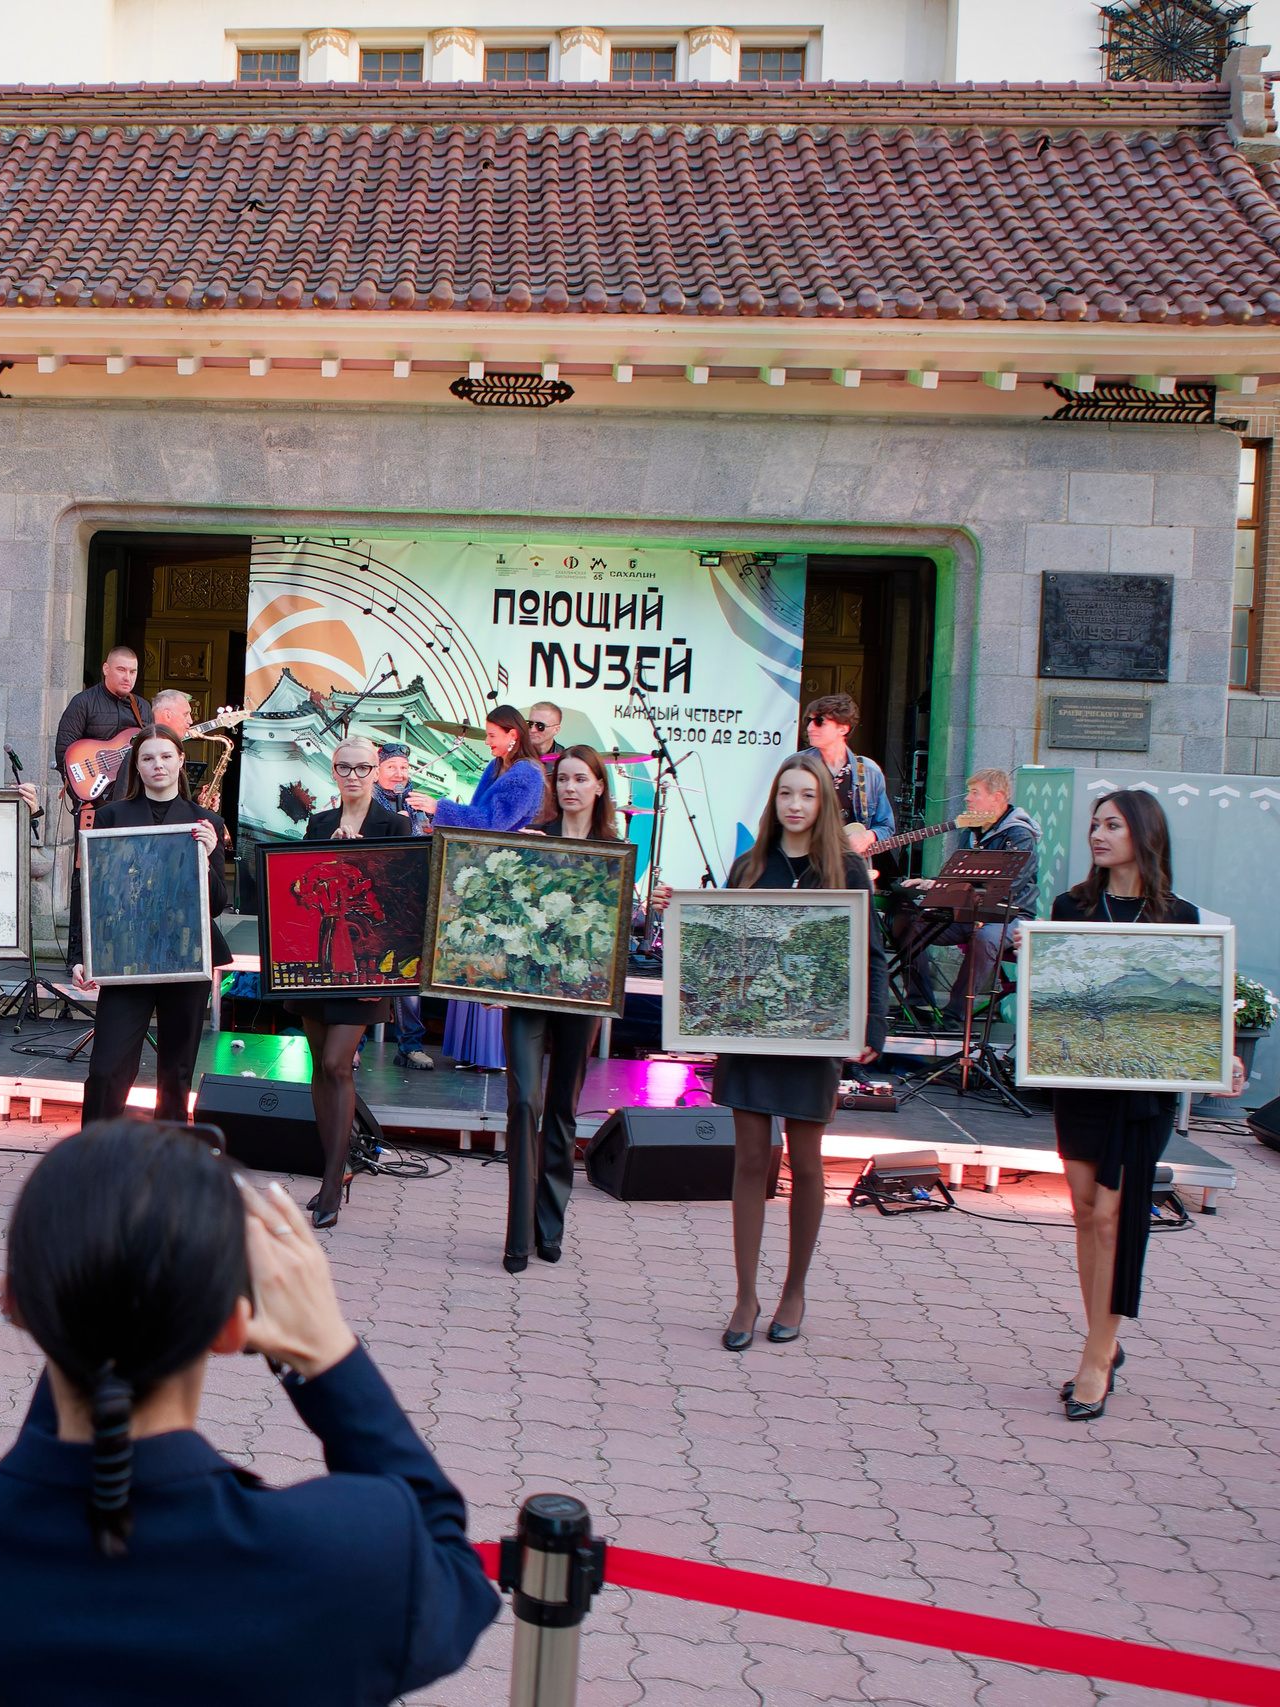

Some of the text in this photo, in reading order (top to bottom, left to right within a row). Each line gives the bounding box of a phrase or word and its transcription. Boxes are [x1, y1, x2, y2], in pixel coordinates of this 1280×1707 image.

[609, 571, 656, 579] САХАЛИН
[493, 587, 664, 632] ПОЮЩИЙ
[1069, 625, 1145, 642] МУЗЕЙ
[529, 637, 693, 694] МУЗЕЙ
[614, 704, 743, 724] КАЖДЫЙ ЧЕТВЕРГ
[666, 726, 707, 743] 19:00
[737, 730, 783, 746] 20:30
